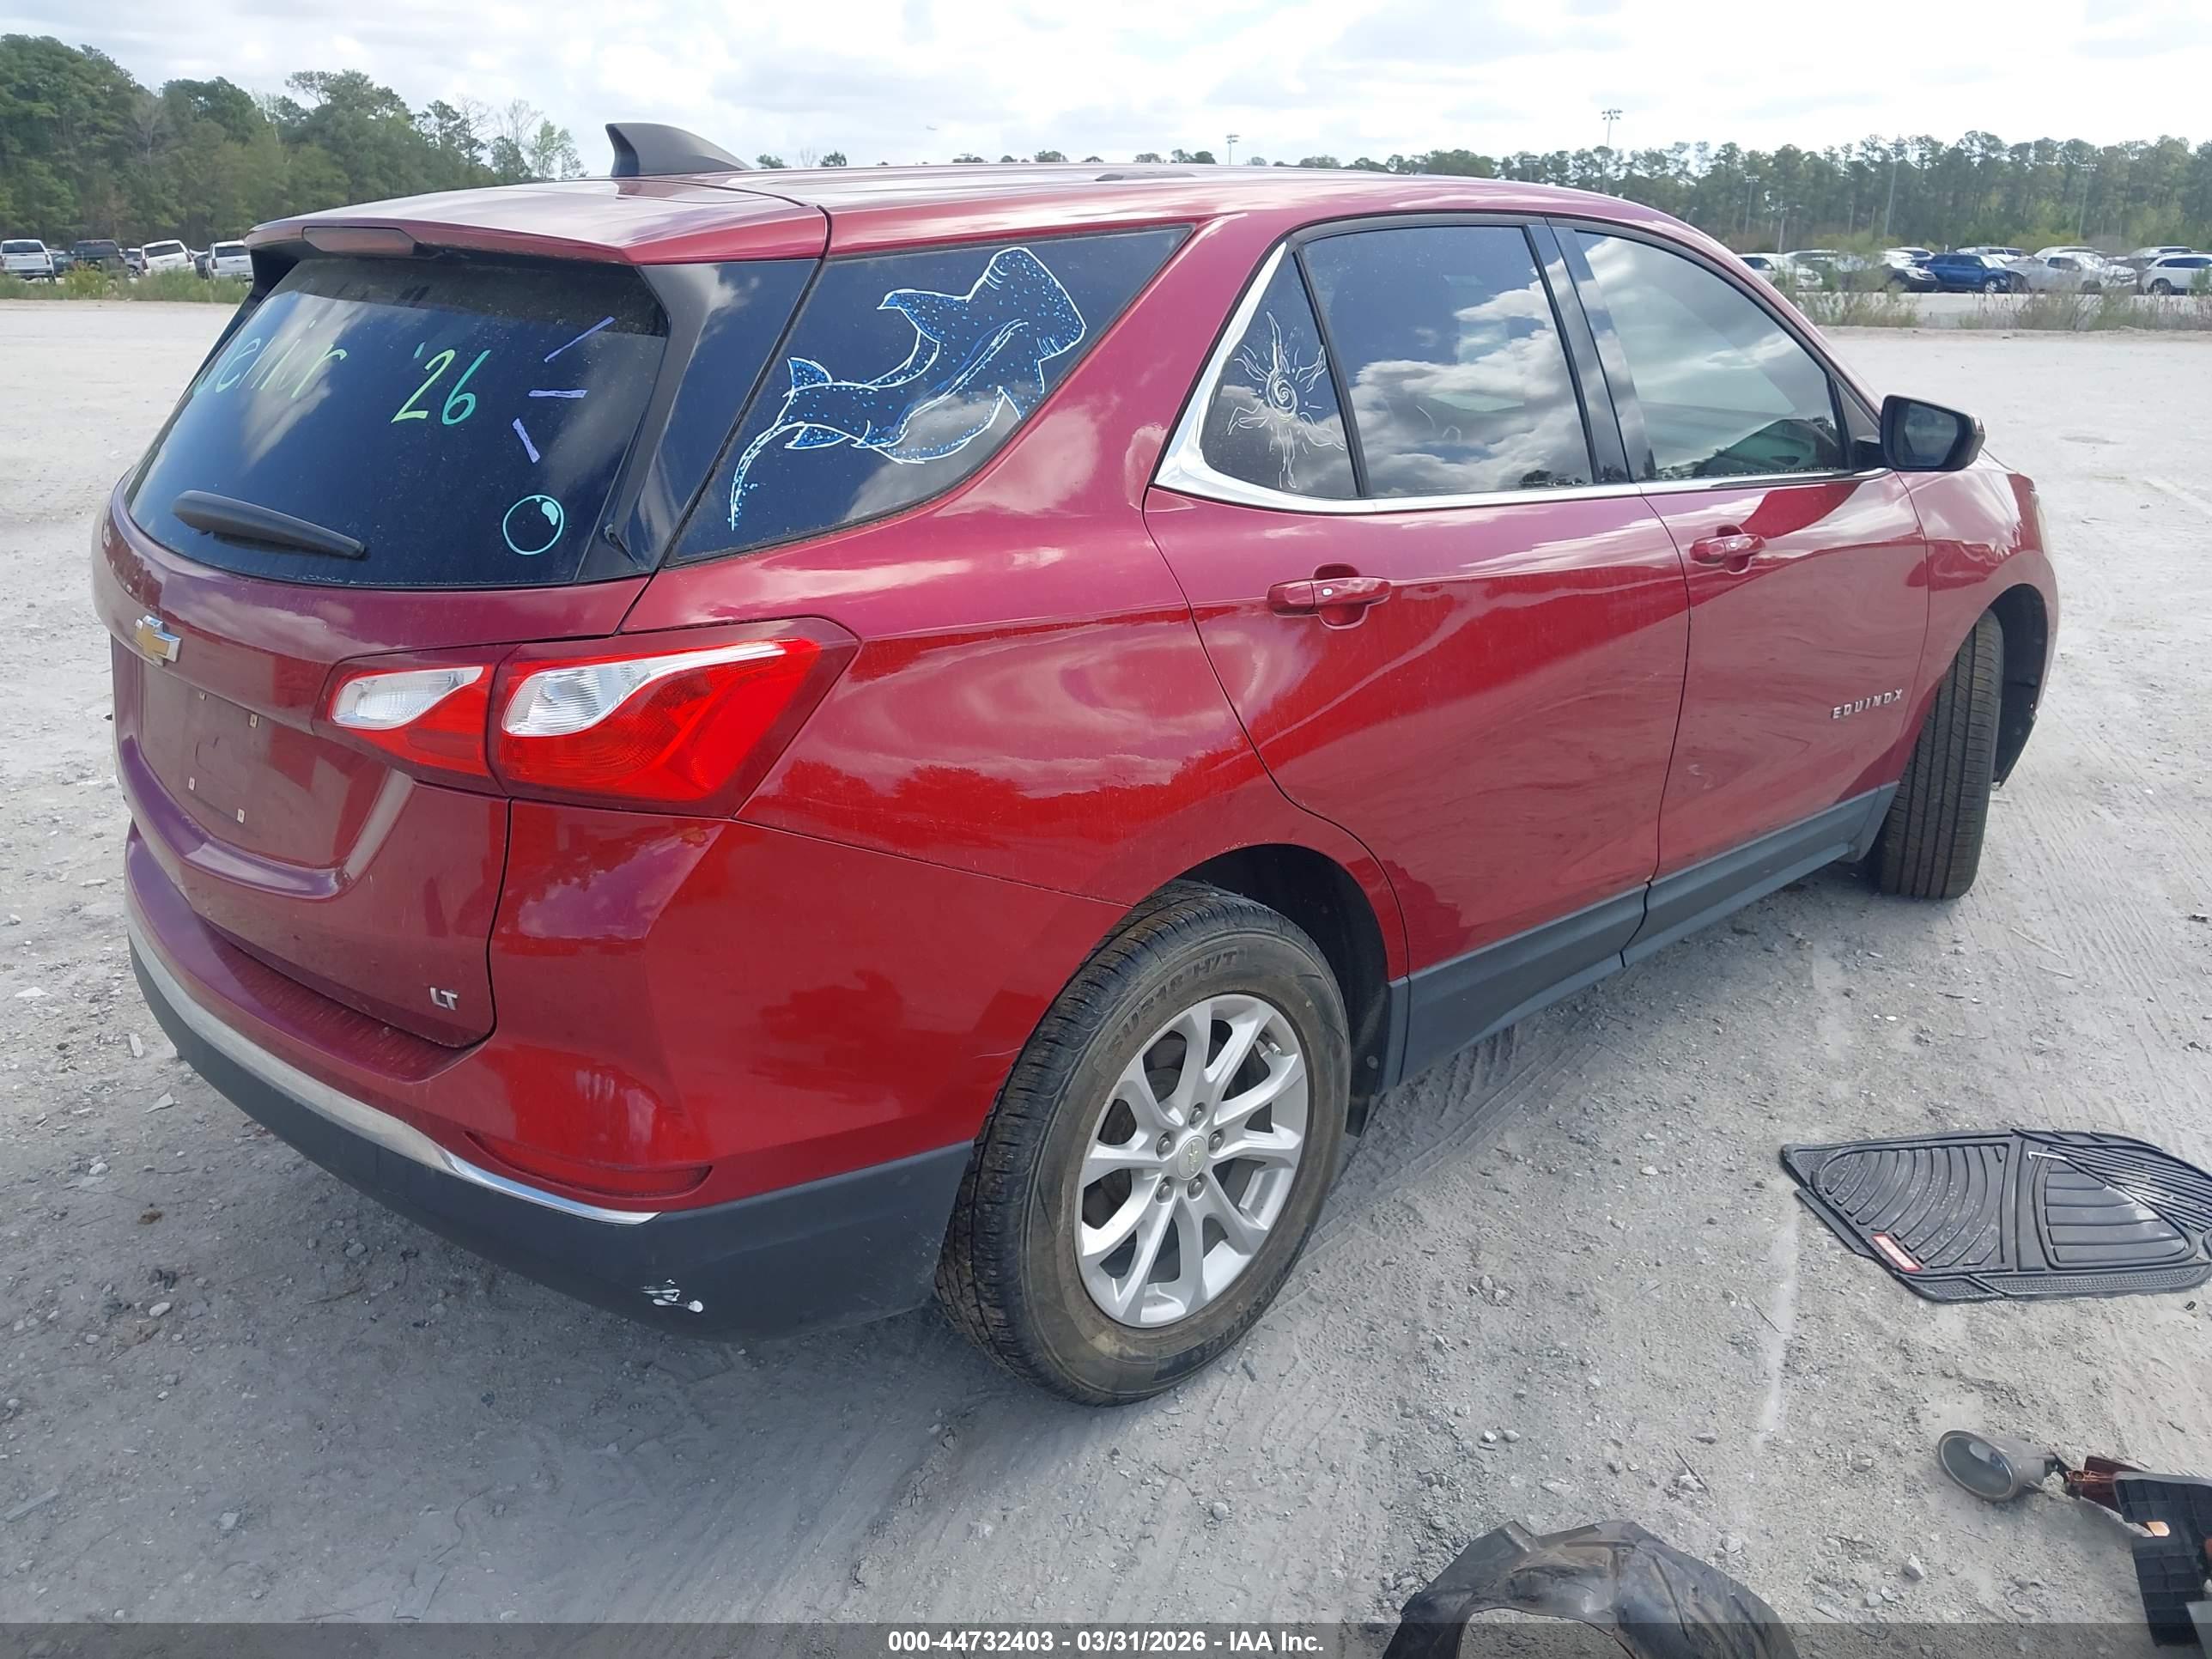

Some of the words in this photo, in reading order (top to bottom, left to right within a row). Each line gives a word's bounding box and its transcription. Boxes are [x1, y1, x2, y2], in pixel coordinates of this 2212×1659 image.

[390, 342, 492, 425] '26
[1831, 688, 1903, 720] EQUINOX
[429, 987, 459, 1011] LT
